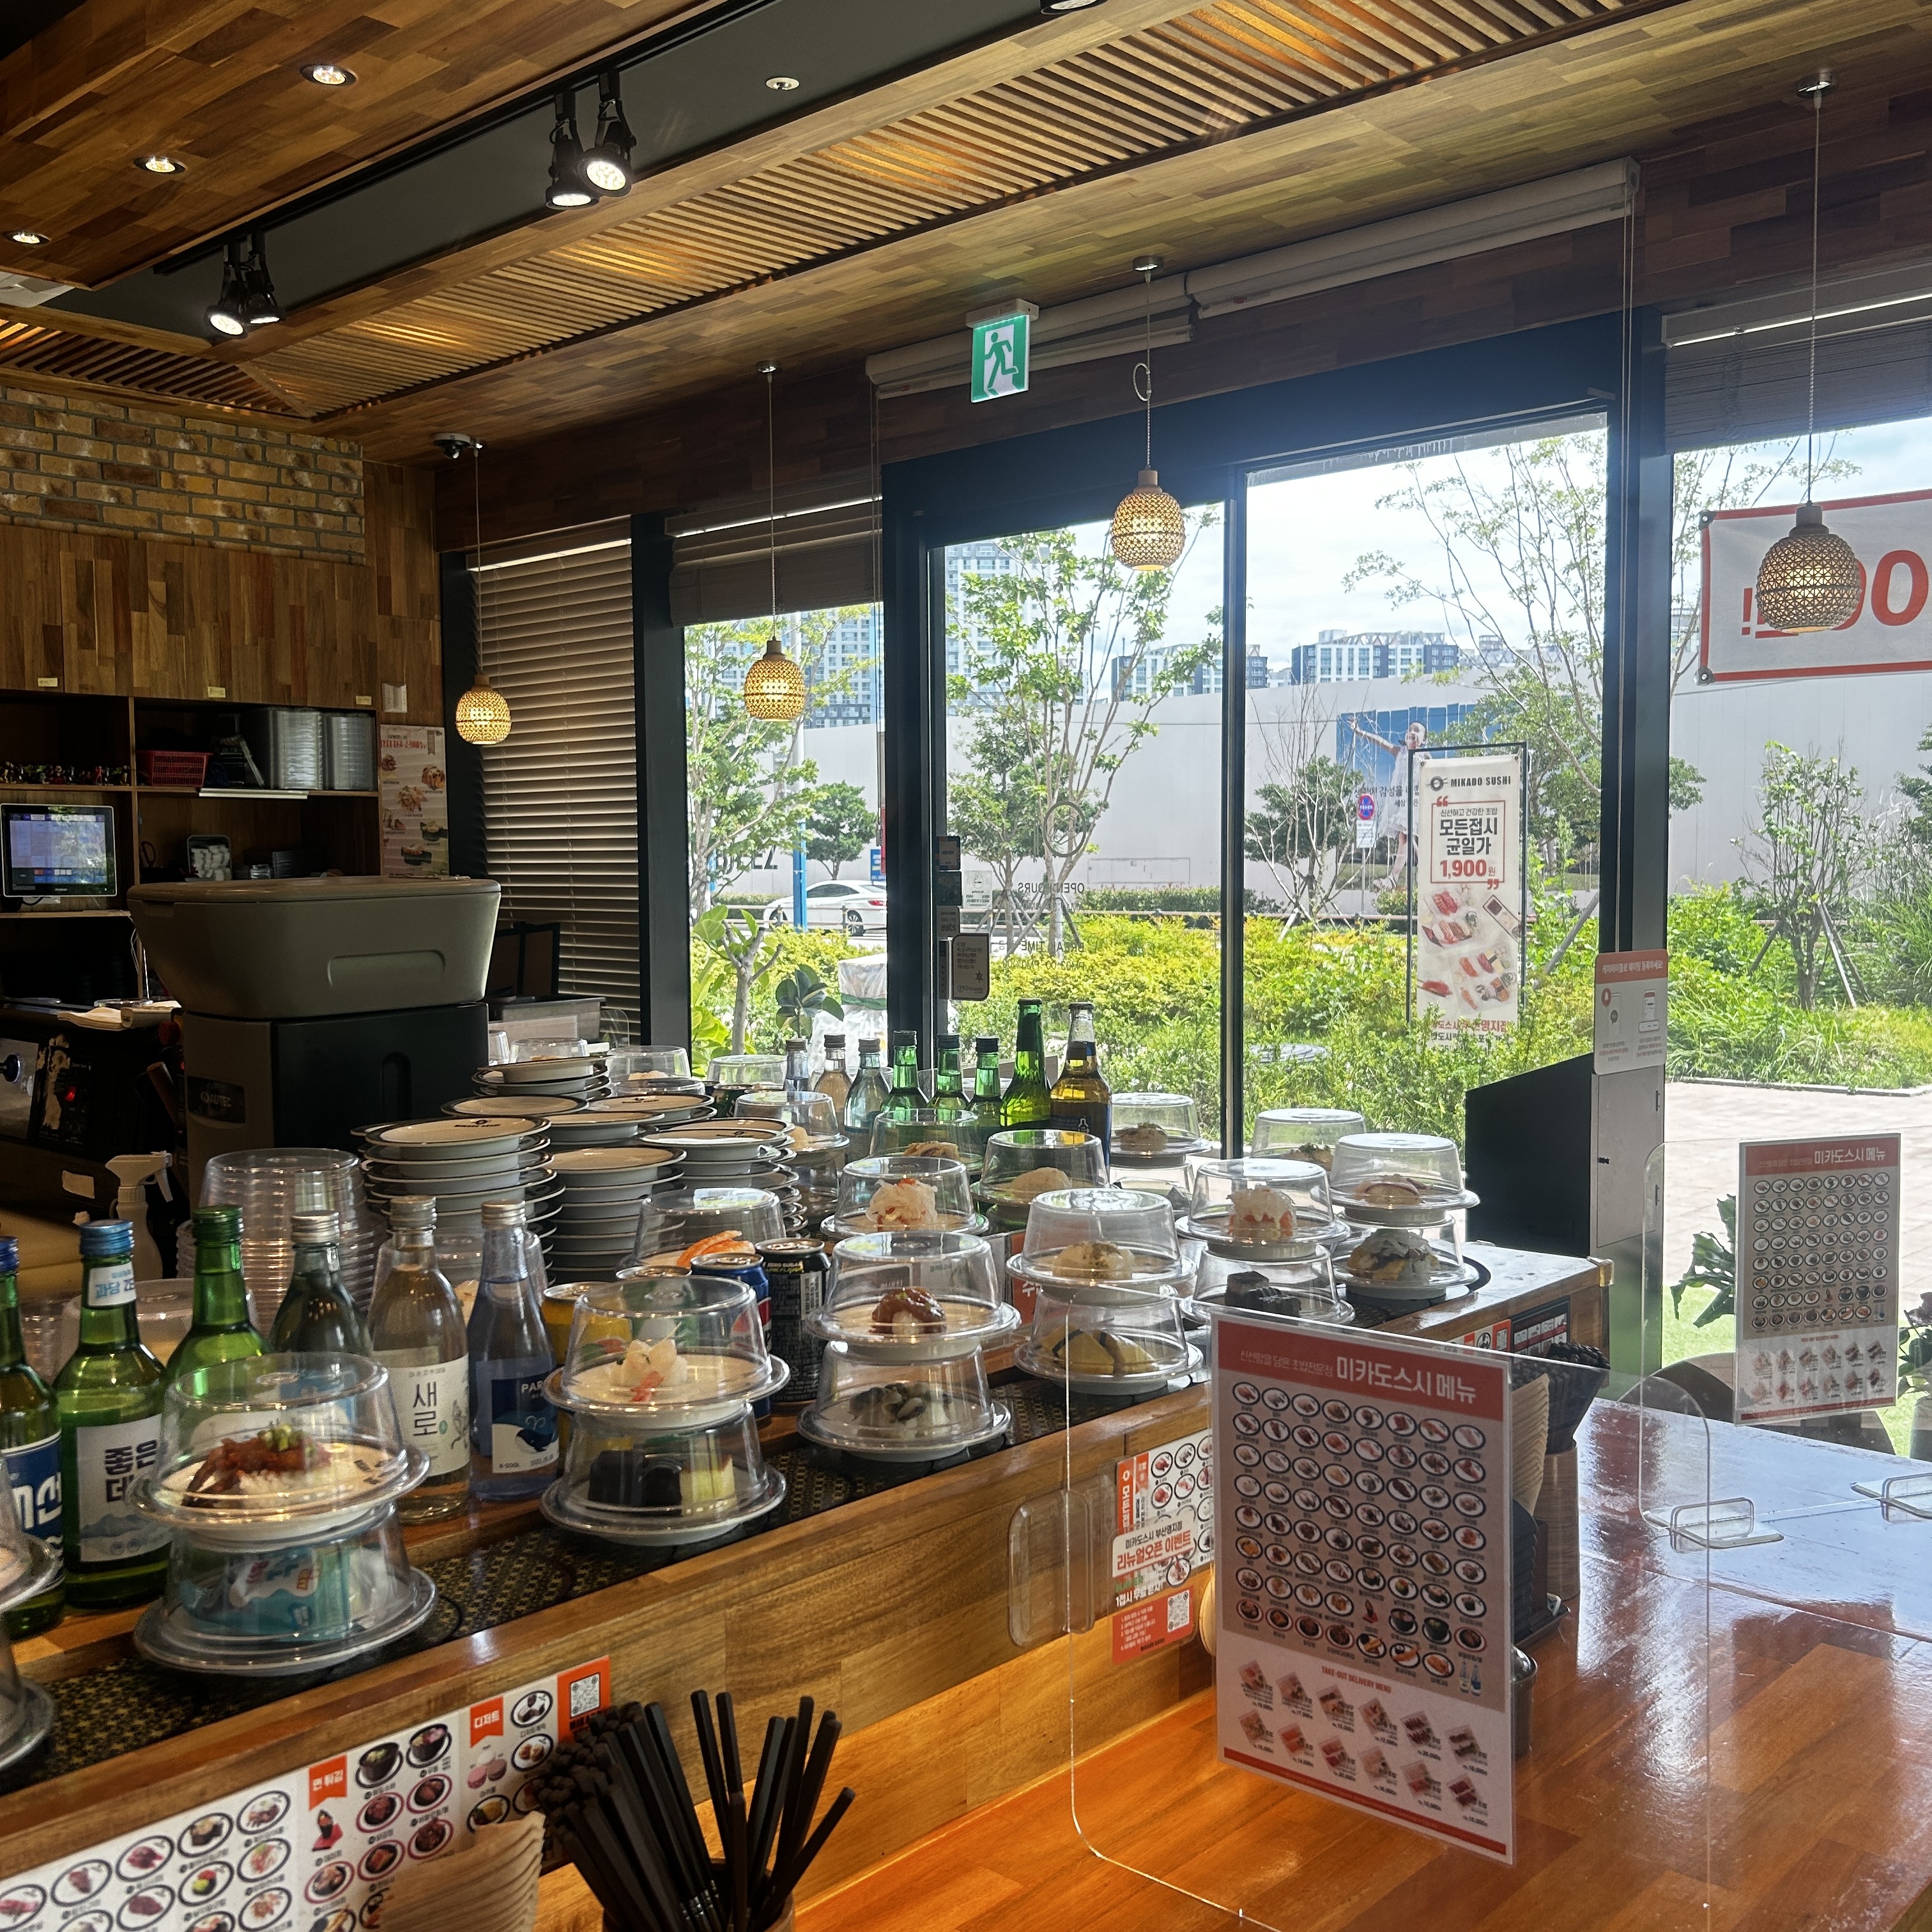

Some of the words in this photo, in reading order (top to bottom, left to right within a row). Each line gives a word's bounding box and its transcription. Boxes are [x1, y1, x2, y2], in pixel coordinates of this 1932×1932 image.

[1451, 777, 1482, 787] MIKADO
[1485, 776, 1511, 785] SUSHI
[1441, 808, 1464, 817] 신선하고
[1466, 808, 1483, 816] 건강한
[1485, 807, 1498, 815] 초밥
[1440, 817, 1497, 836] 모든접시
[1446, 837, 1491, 855] 균일가
[941, 923, 956, 931] eats
[1814, 1147, 1864, 1165] 미카도스시
[1866, 1147, 1886, 1162] 메뉴
[521, 1380, 544, 1393] PAR
[1337, 1356, 1430, 1397] 미카도스시
[1436, 1373, 1476, 1404] 메뉴
[413, 1381, 438, 1436] 새로
[104, 1439, 158, 1475] 좋은
[1125, 1531, 1154, 1549] 미카도스시
[1117, 1540, 1163, 1570] 리뉴얼오픈
[1165, 1529, 1192, 1553] 이벤트
[474, 1709, 500, 1729] 디저트
